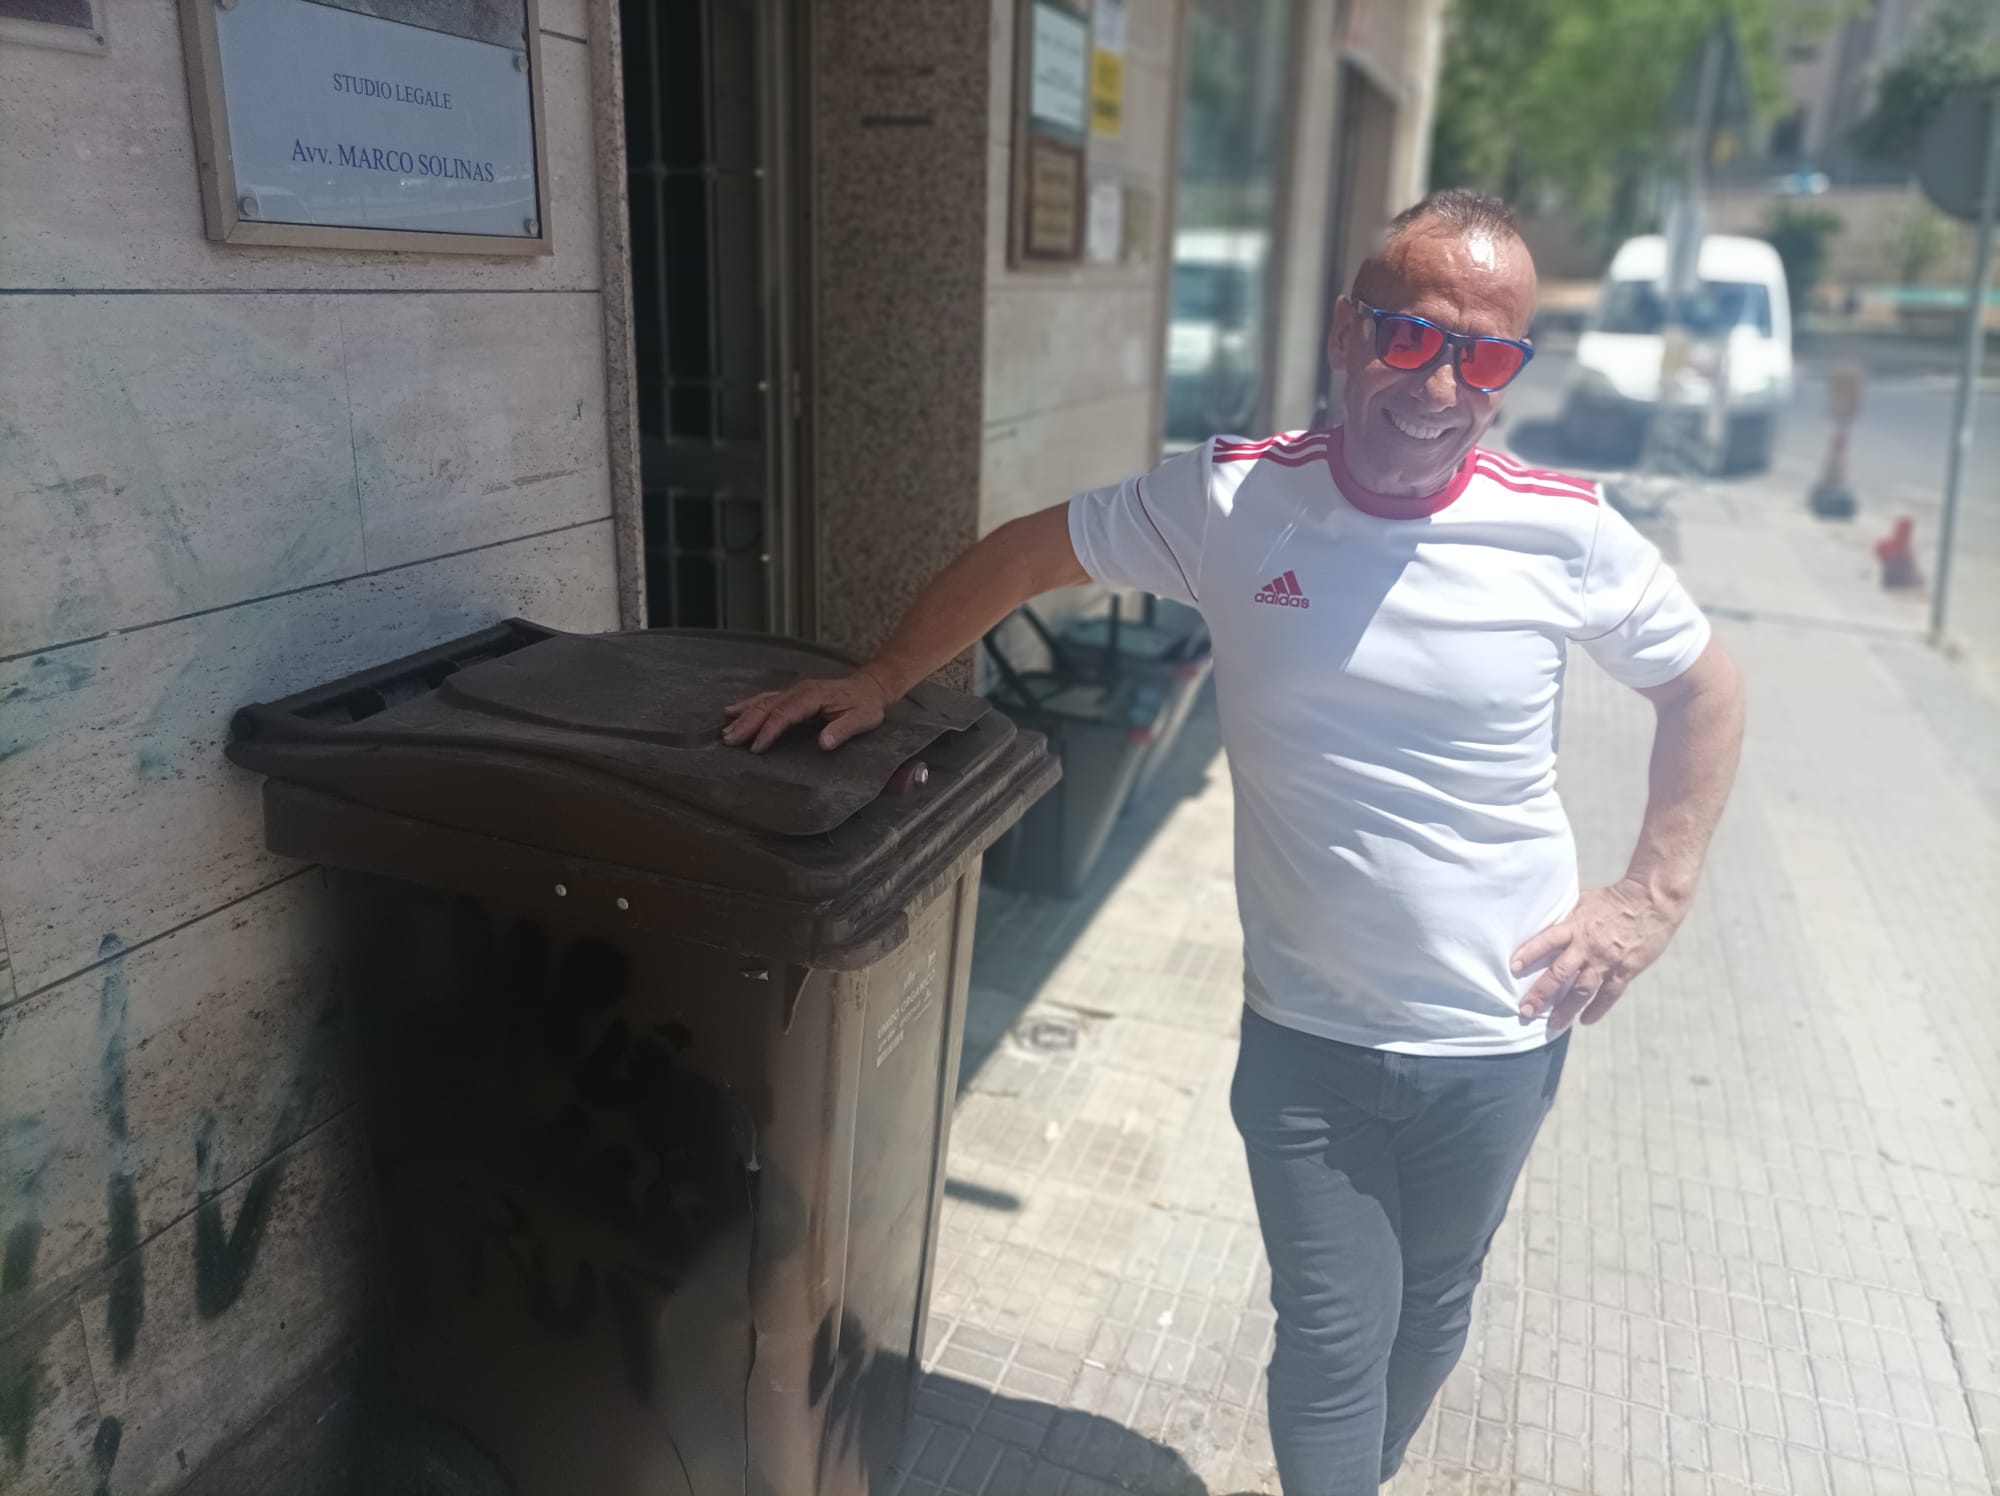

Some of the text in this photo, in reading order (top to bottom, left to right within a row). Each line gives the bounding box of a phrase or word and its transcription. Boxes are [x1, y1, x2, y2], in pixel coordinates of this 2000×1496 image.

[333, 73, 453, 110] STUDIO LEGALE
[338, 143, 414, 174] MARCO
[418, 153, 495, 183] SOLINAS
[1254, 591, 1310, 609] adidas
